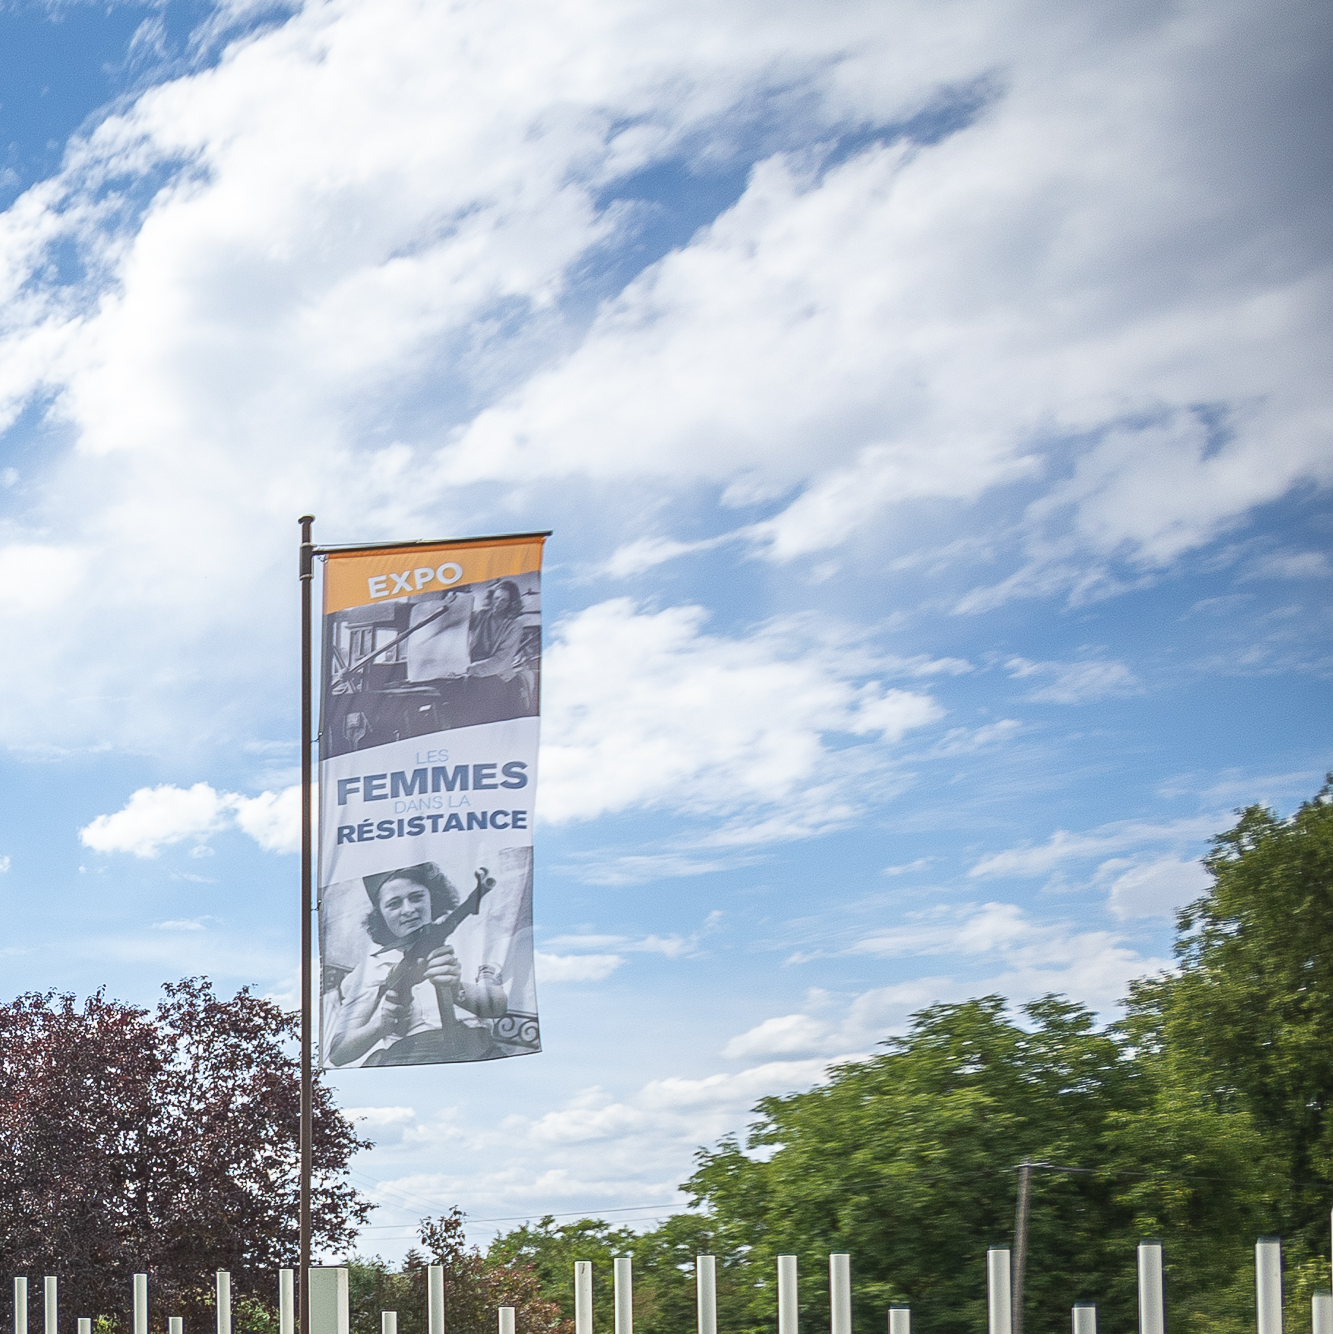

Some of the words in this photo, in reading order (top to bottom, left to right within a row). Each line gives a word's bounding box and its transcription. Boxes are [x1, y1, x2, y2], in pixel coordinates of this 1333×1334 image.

[368, 562, 463, 599] EXPO
[416, 749, 449, 765] LES
[337, 760, 529, 806] FEMMES
[394, 796, 443, 814] DANS
[448, 794, 471, 808] LA
[337, 809, 528, 845] RÉSISTANCE
